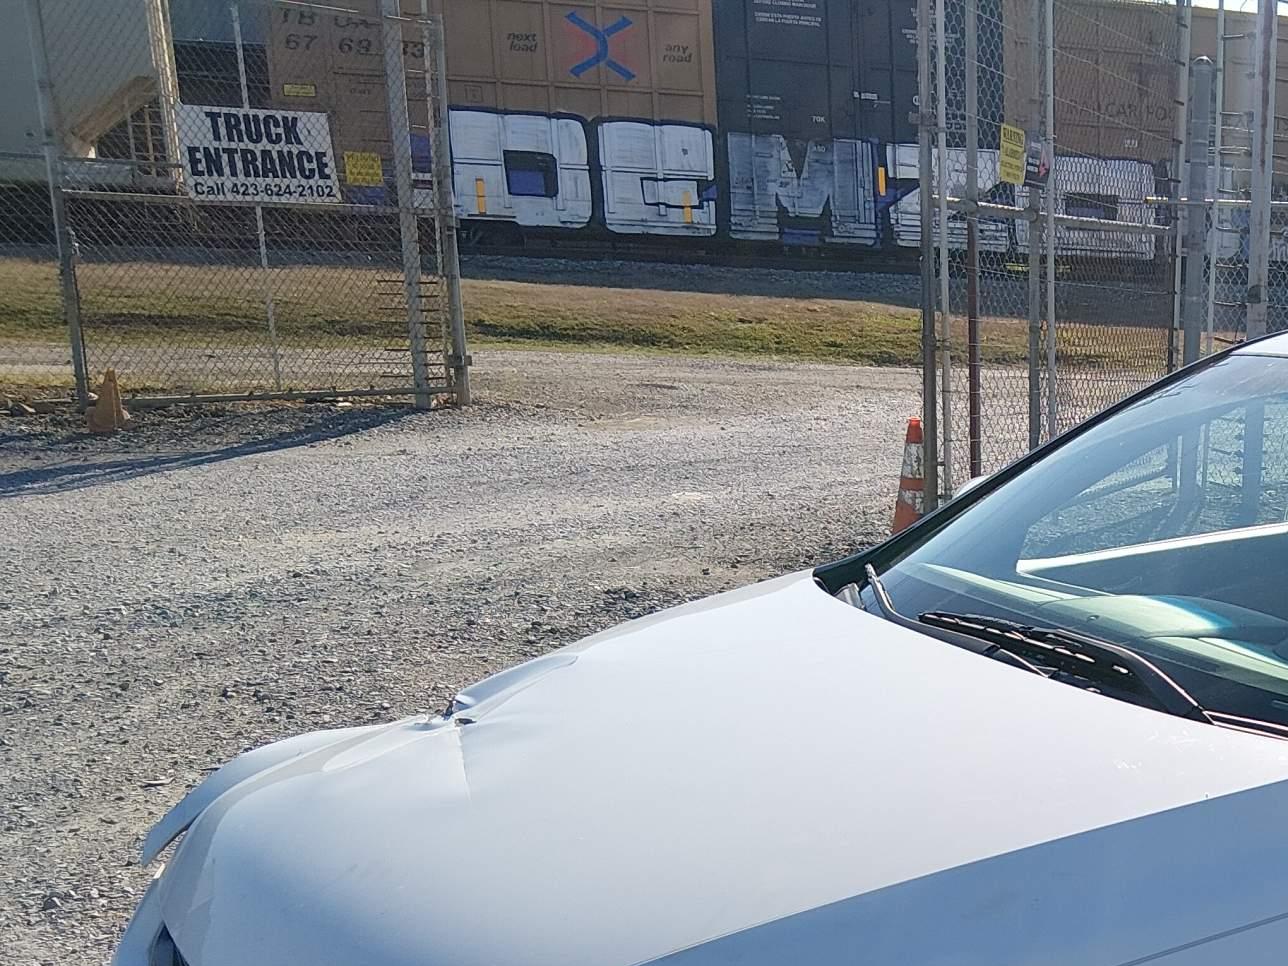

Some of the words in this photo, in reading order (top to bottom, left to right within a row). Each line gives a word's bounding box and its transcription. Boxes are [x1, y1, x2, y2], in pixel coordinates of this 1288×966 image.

[285, 33, 318, 51] 67
[506, 31, 537, 43] next
[509, 41, 538, 52] load
[664, 43, 689, 55] any
[662, 52, 692, 63] road
[204, 111, 304, 146] TRUCK
[187, 146, 332, 180] ENTRANCE
[194, 182, 225, 196] Call
[231, 182, 337, 199] 423-624-2102
